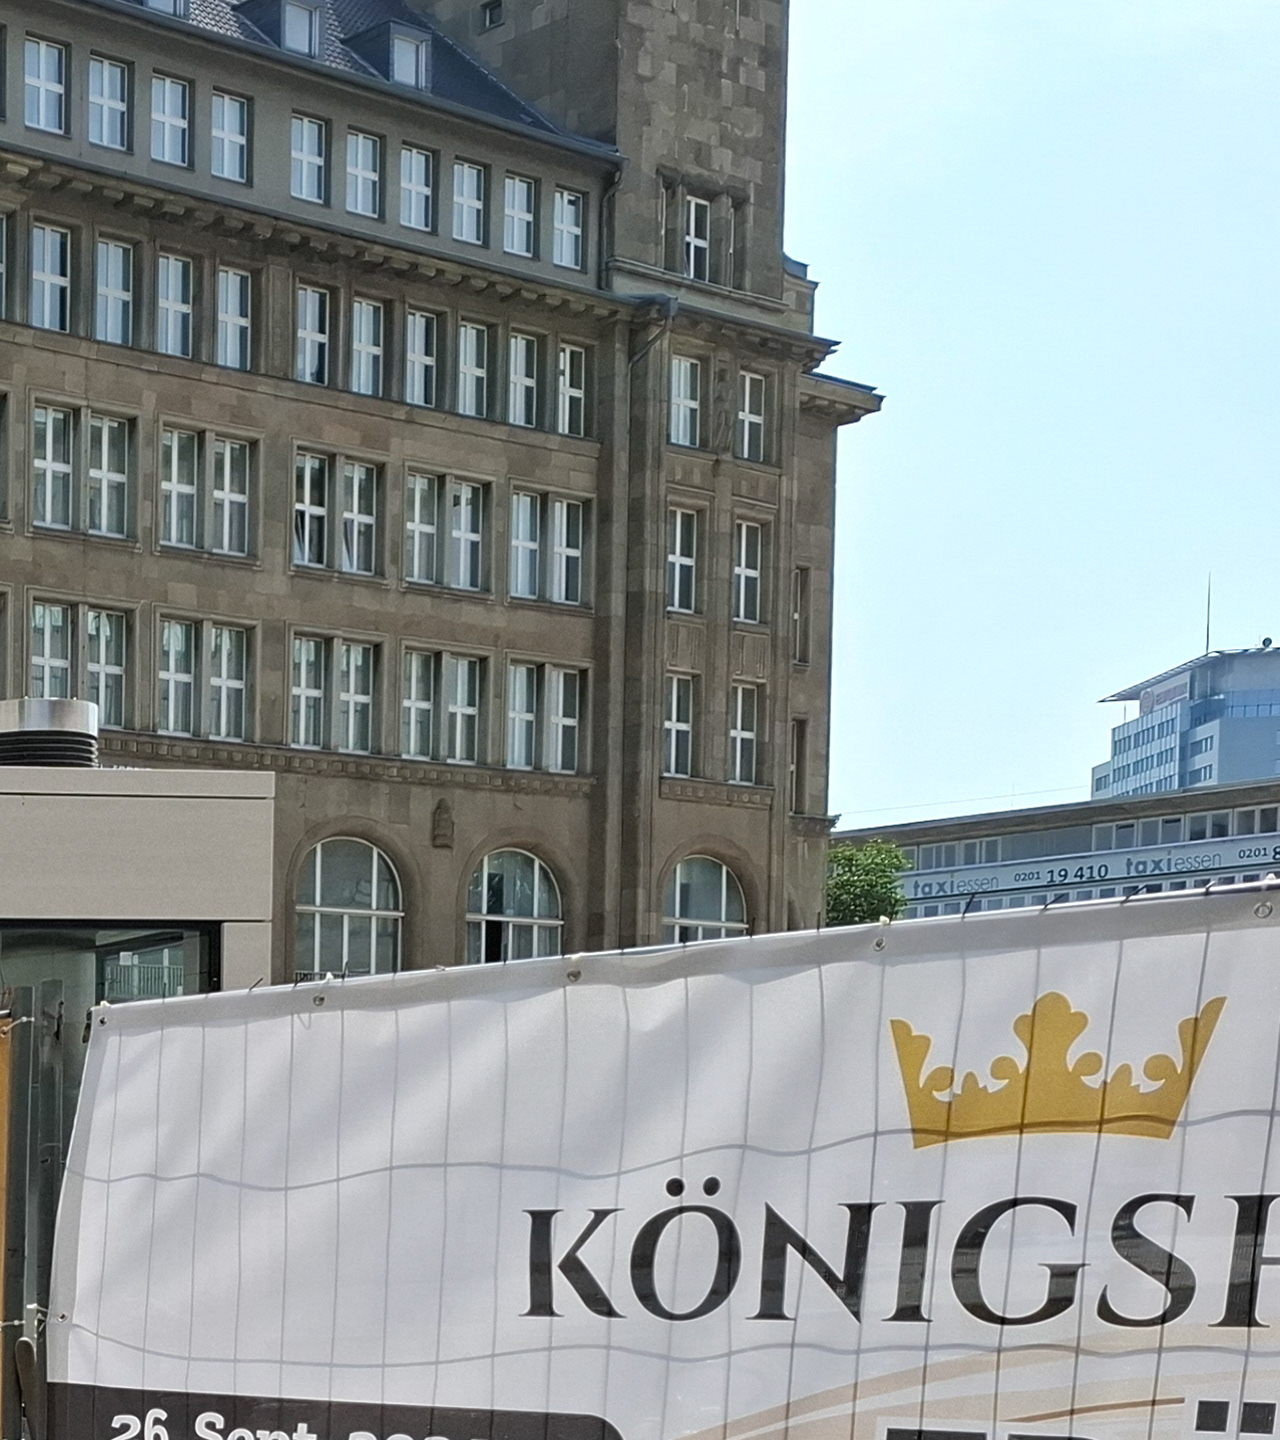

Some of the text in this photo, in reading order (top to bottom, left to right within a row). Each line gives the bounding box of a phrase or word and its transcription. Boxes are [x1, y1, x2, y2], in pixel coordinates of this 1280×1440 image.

[1238, 847, 1269, 860] 0201
[1014, 871, 1042, 882] 0201
[1046, 868, 1069, 884] 19
[1074, 864, 1109, 880] 410
